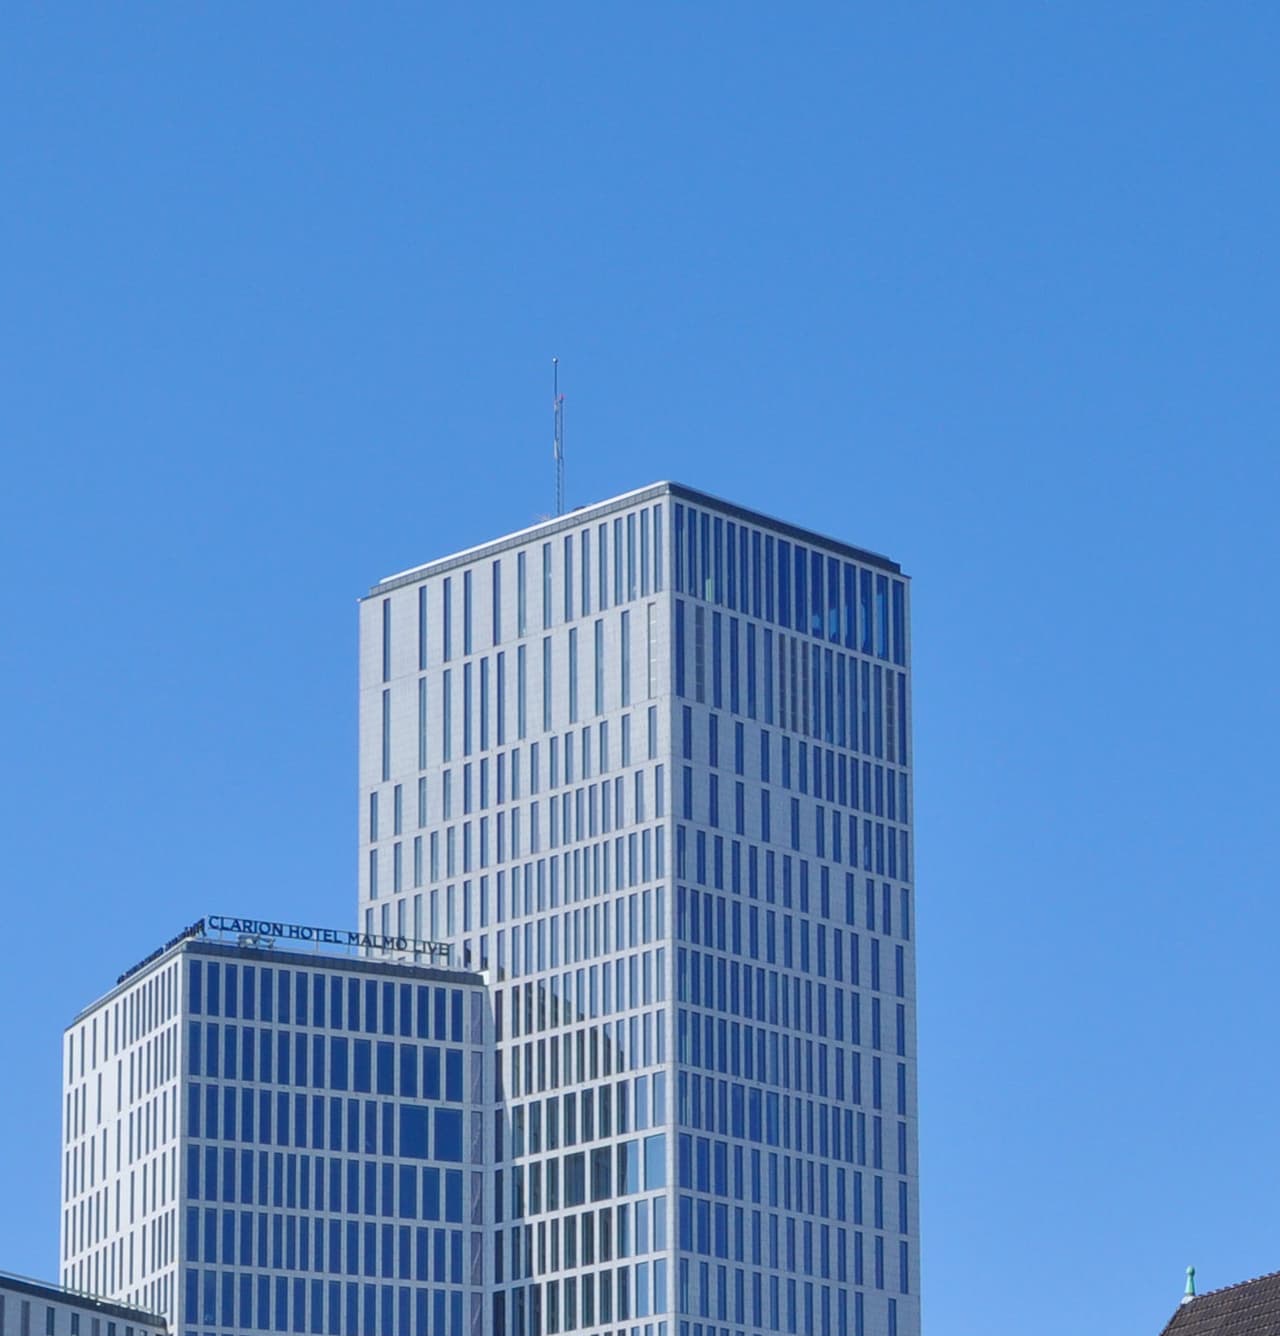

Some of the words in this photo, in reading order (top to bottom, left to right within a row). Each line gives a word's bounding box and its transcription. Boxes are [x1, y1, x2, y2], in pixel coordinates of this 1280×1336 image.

[208, 915, 283, 937] CLARION
[288, 924, 341, 944] HOTEL
[348, 931, 408, 951] MALMÖ
[414, 939, 450, 956] LIVE
